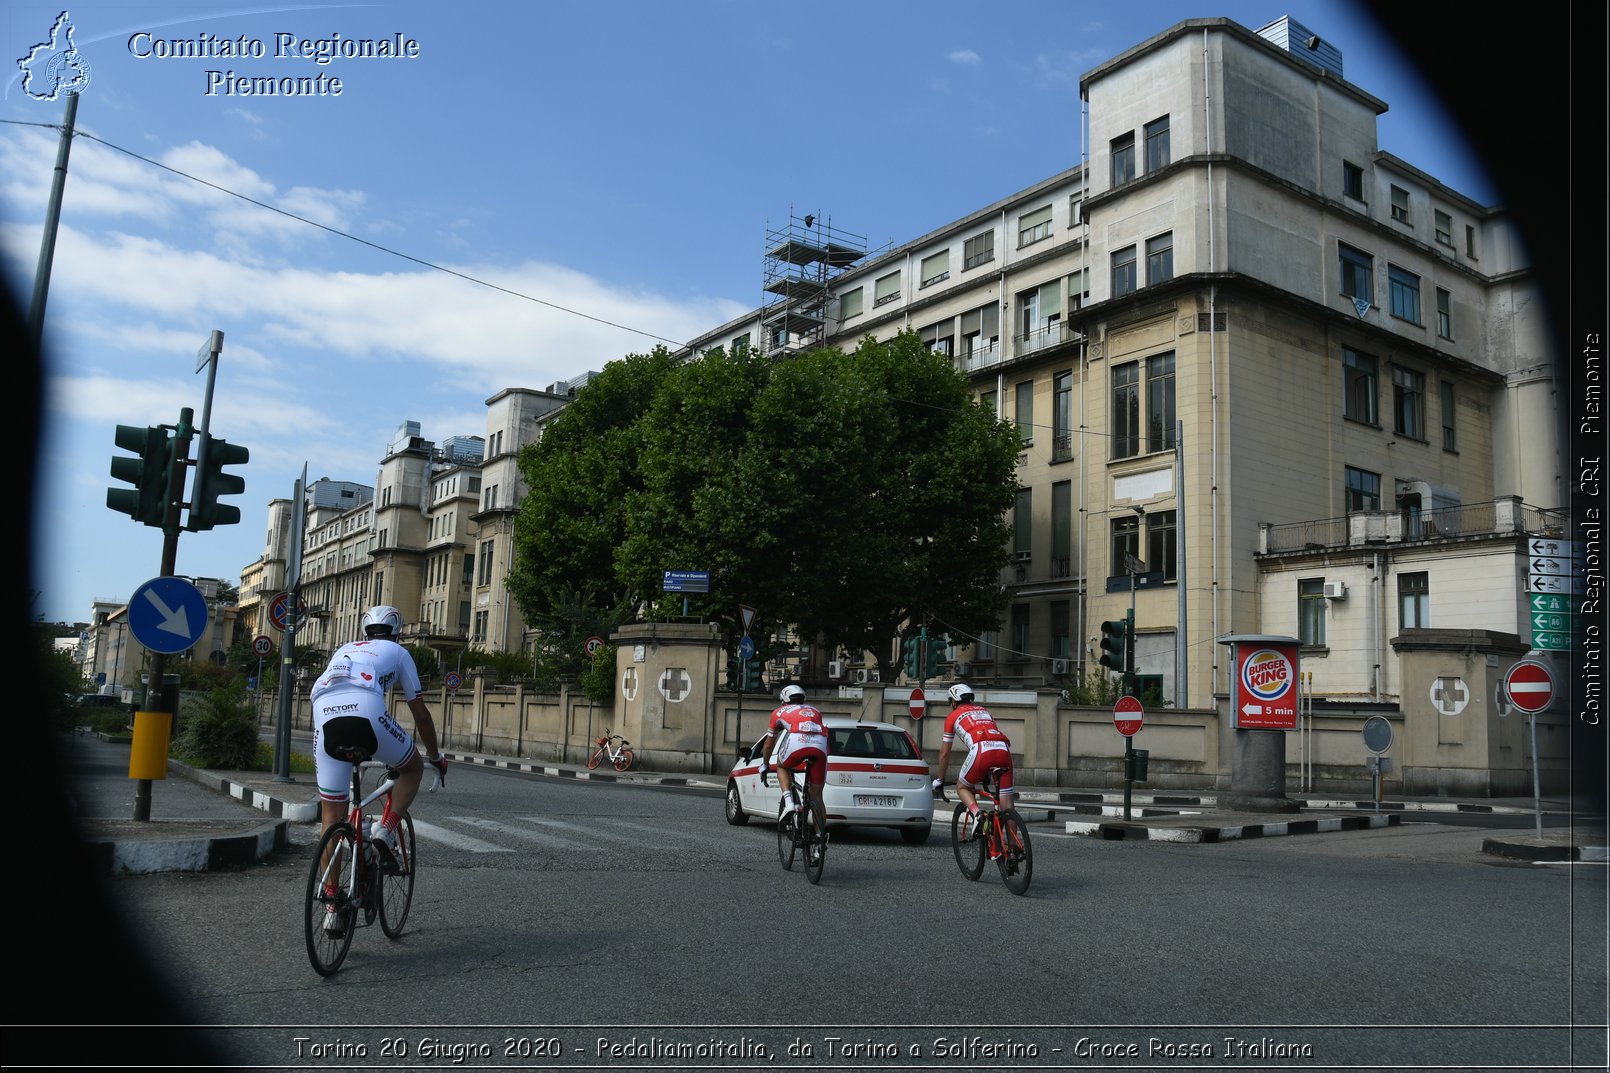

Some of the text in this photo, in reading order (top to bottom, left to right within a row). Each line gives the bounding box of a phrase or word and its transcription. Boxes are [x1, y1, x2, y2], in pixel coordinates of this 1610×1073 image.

[257, 641, 269, 651] 30
[1249, 659, 1286, 676] BURGER
[1250, 667, 1287, 689] KING
[323, 703, 359, 714] FACTORY
[1265, 706, 1293, 716] 5 min
